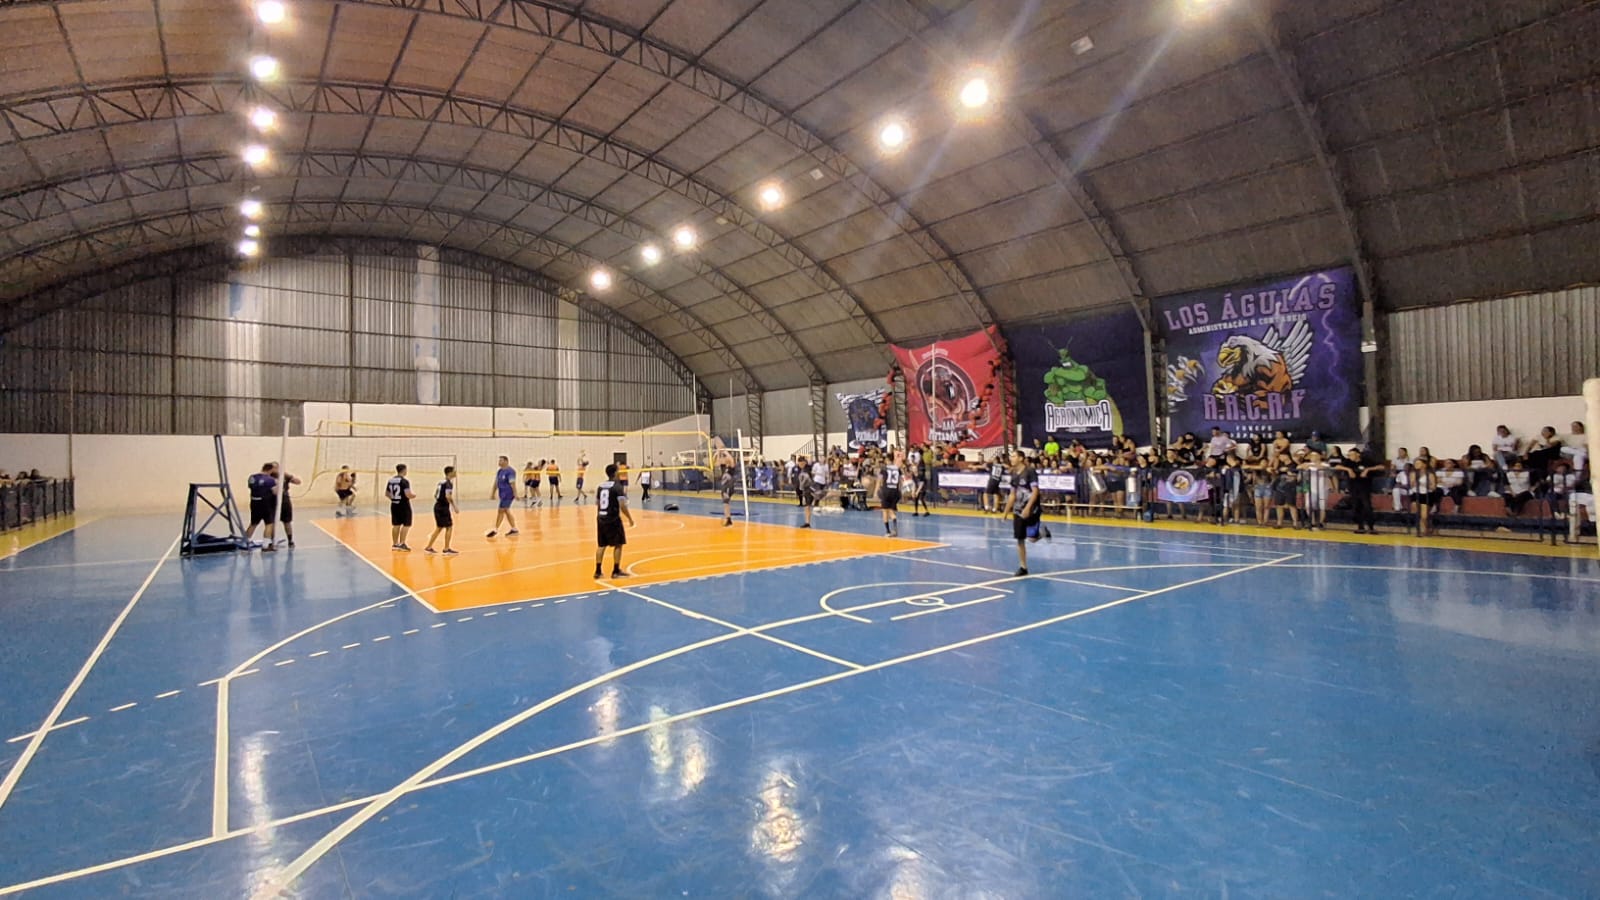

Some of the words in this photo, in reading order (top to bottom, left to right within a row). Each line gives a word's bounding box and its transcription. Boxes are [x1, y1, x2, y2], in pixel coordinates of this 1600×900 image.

[1164, 302, 1209, 330] LOS
[1221, 283, 1336, 321] ÁGUIAS
[886, 469, 899, 484] 13
[389, 484, 402, 500] 12
